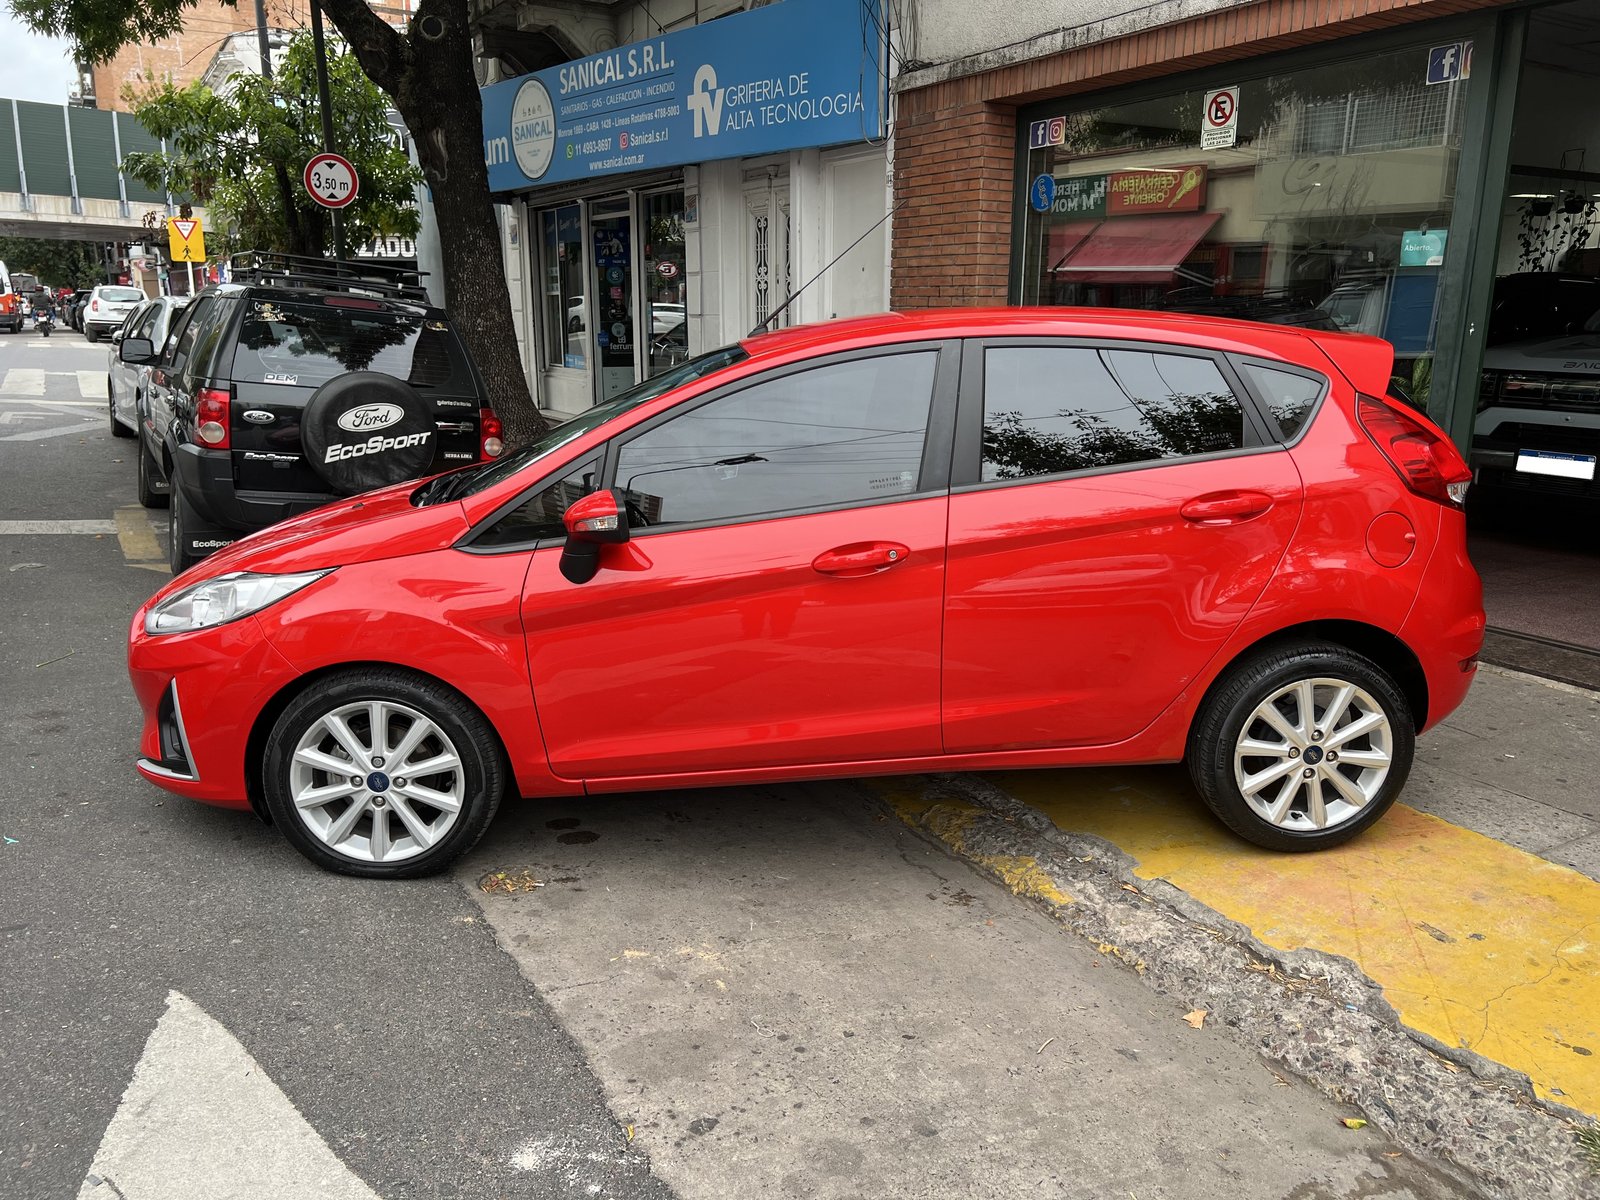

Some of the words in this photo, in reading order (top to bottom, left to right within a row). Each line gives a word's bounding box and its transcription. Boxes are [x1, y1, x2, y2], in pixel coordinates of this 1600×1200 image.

[560, 54, 625, 95] SANICAL
[628, 41, 675, 78] S.R.L.
[561, 101, 589, 116] SANITARIOS
[592, 98, 603, 109] GAS
[606, 88, 642, 105] CALEFACCION
[646, 81, 676, 96] INCENDIO
[725, 78, 785, 107] GRIFERIA
[789, 72, 809, 96] DE
[687, 64, 724, 138] fv
[725, 110, 755, 131] ALTA
[760, 91, 865, 126] TECNOLOGIA
[514, 120, 553, 141] SANICAL
[586, 122, 599, 134] CABA
[630, 111, 654, 124] Rotativas
[575, 143, 582, 155] 11
[1204, 134, 1231, 142] ESTACIONAR
[589, 154, 644, 170] www.sanical.com.ar
[313, 171, 337, 191] 3,50
[339, 181, 349, 191] m
[352, 407, 392, 428] Ford
